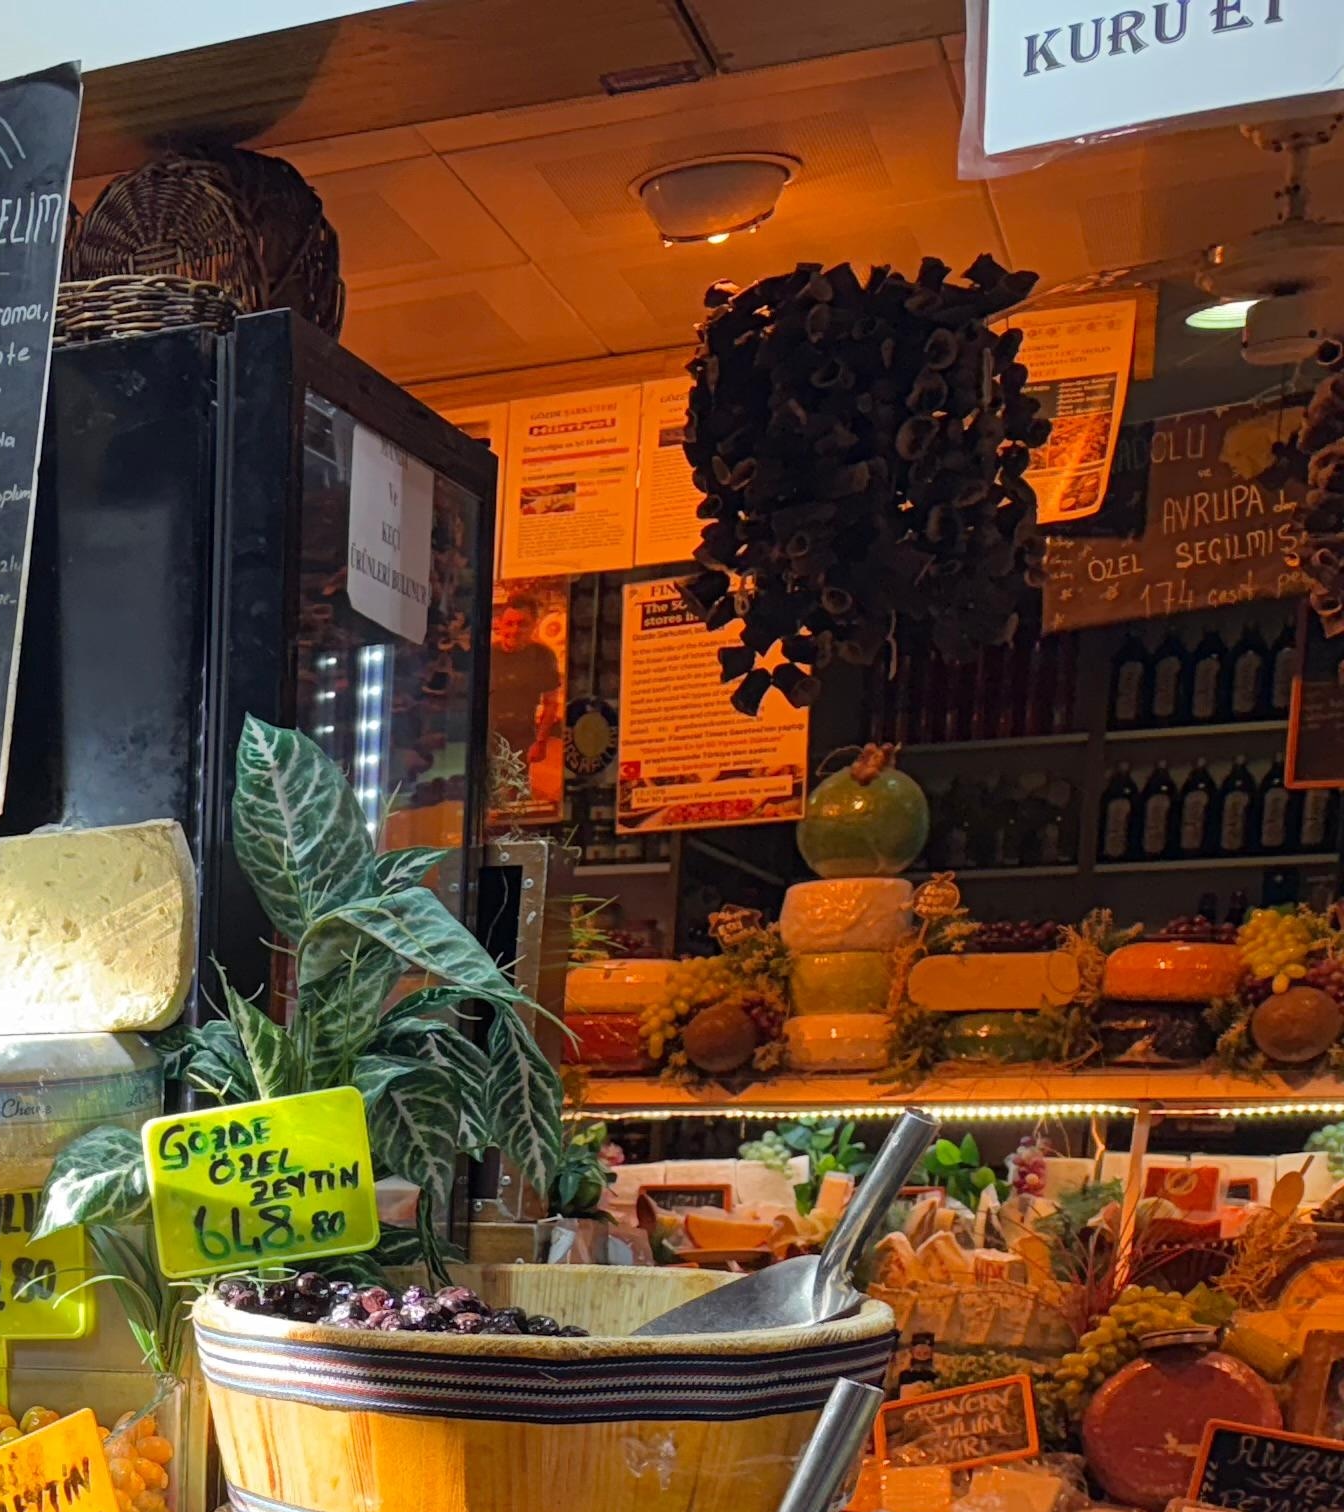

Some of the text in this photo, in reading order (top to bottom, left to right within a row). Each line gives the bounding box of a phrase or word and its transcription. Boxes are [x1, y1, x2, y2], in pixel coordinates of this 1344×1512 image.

[1023, 0, 1191, 77] KURU
[1161, 484, 1265, 536] AVRUPA
[159, 1115, 272, 1171] GÖZDE
[208, 1143, 300, 1187] ÖZEL
